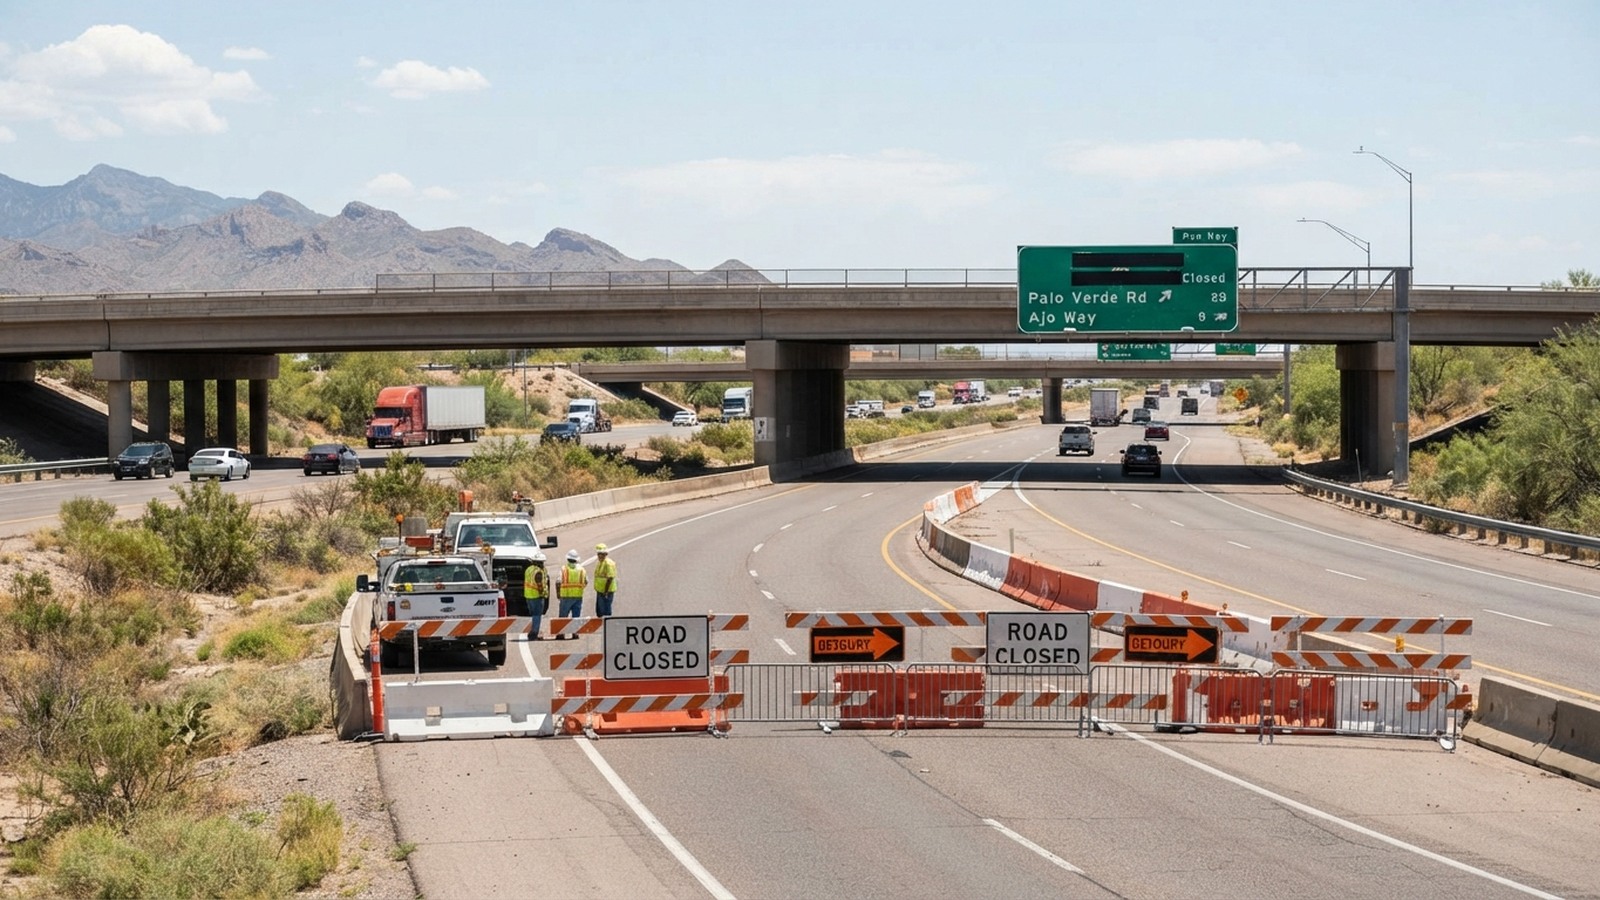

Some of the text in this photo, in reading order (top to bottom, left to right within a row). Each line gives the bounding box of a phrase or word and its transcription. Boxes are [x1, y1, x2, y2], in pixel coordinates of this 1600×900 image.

[1182, 273, 1225, 284] Closed
[1028, 291, 1147, 304] Palo Verde Rd
[1029, 312, 1097, 327] Ajo Way
[625, 625, 687, 645] ROAD
[1008, 622, 1068, 641] ROAD
[614, 651, 699, 671] CLOSED
[995, 647, 1080, 665] CLOSED
